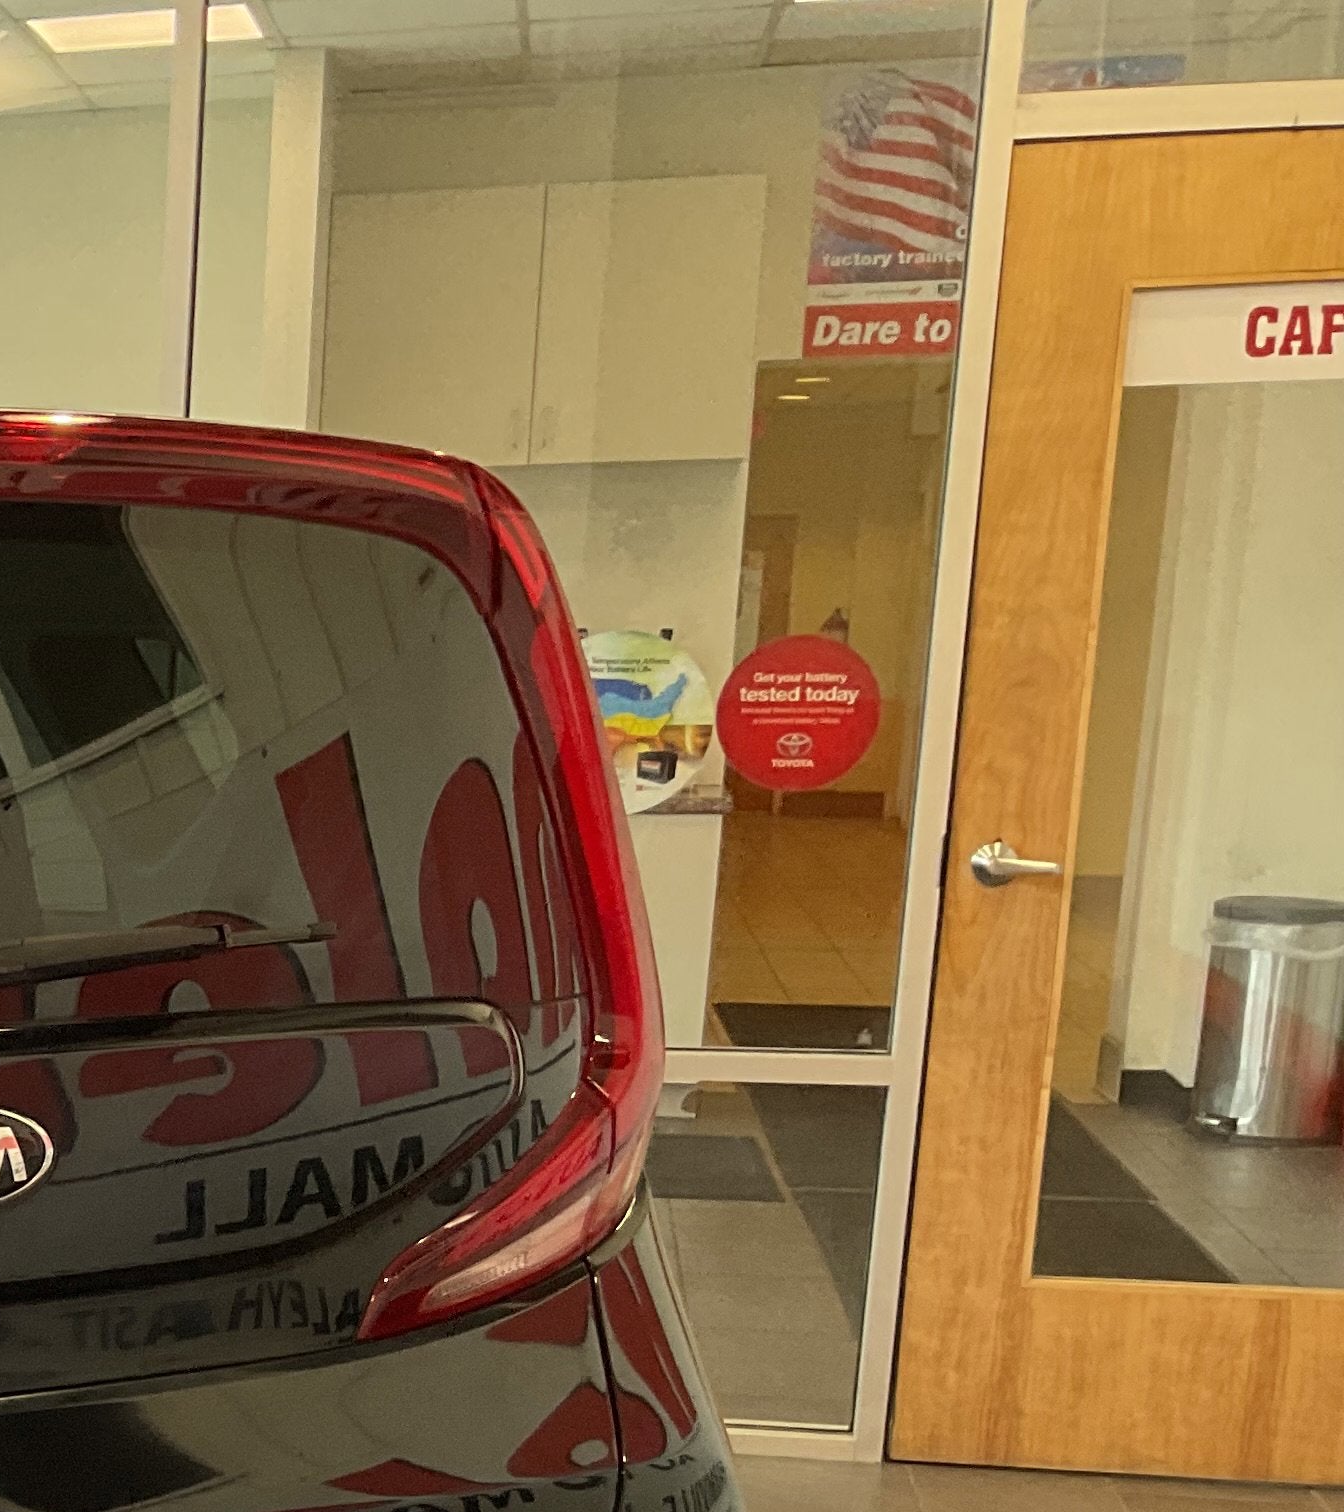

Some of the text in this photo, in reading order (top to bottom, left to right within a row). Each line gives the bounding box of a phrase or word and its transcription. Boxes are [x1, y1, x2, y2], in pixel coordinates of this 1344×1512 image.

[812, 312, 952, 346] Dare to
[753, 671, 848, 684] Get your battery
[739, 686, 860, 705] tested today
[771, 758, 814, 768] TOYOTA
